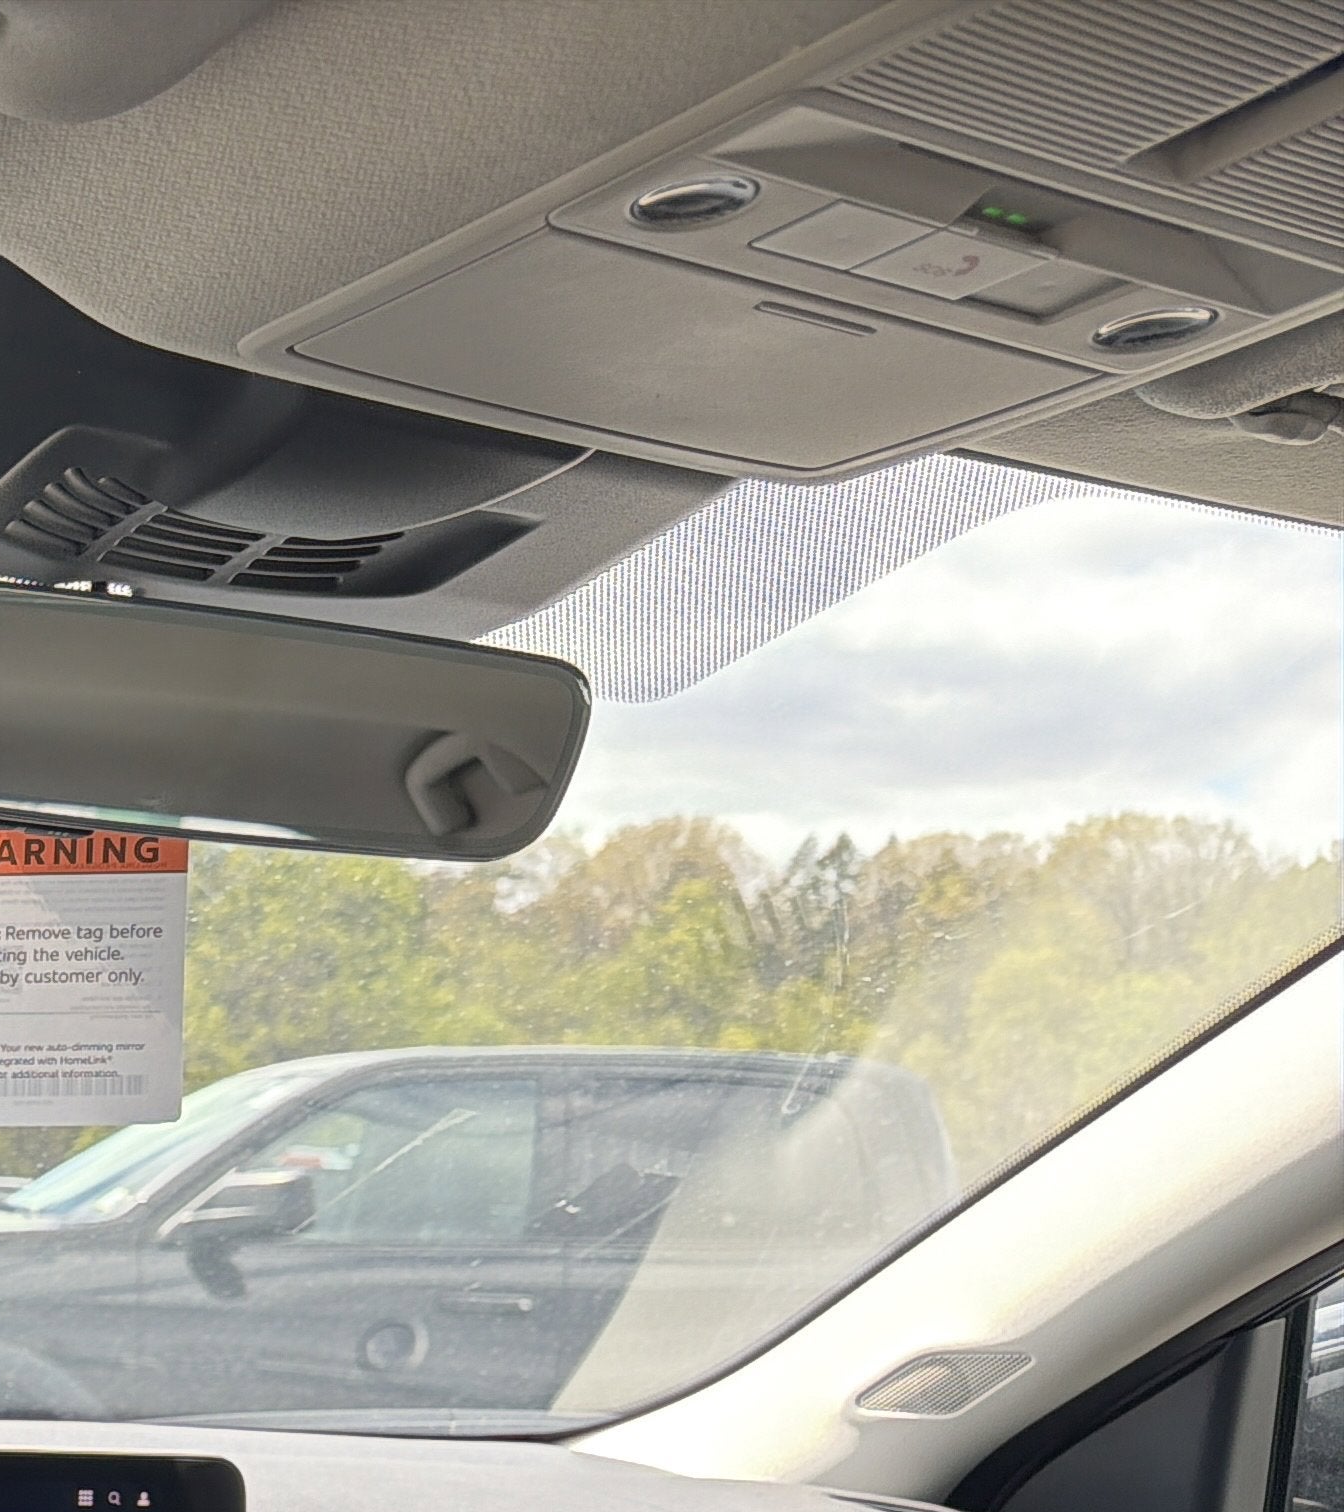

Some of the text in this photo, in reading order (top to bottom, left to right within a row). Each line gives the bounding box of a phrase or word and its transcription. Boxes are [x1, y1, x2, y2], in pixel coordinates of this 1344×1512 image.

[6, 925, 71, 941] Remove
[77, 924, 103, 943] tag
[110, 924, 163, 939] before
[33, 947, 60, 962] the
[65, 946, 125, 961] vehicle.
[0, 970, 20, 988] by
[24, 970, 102, 984] customer
[107, 968, 145, 985] only.
[0, 1044, 21, 1053] Your
[24, 1045, 44, 1053] new
[116, 1042, 146, 1051] mirror
[37, 1056, 58, 1066] with
